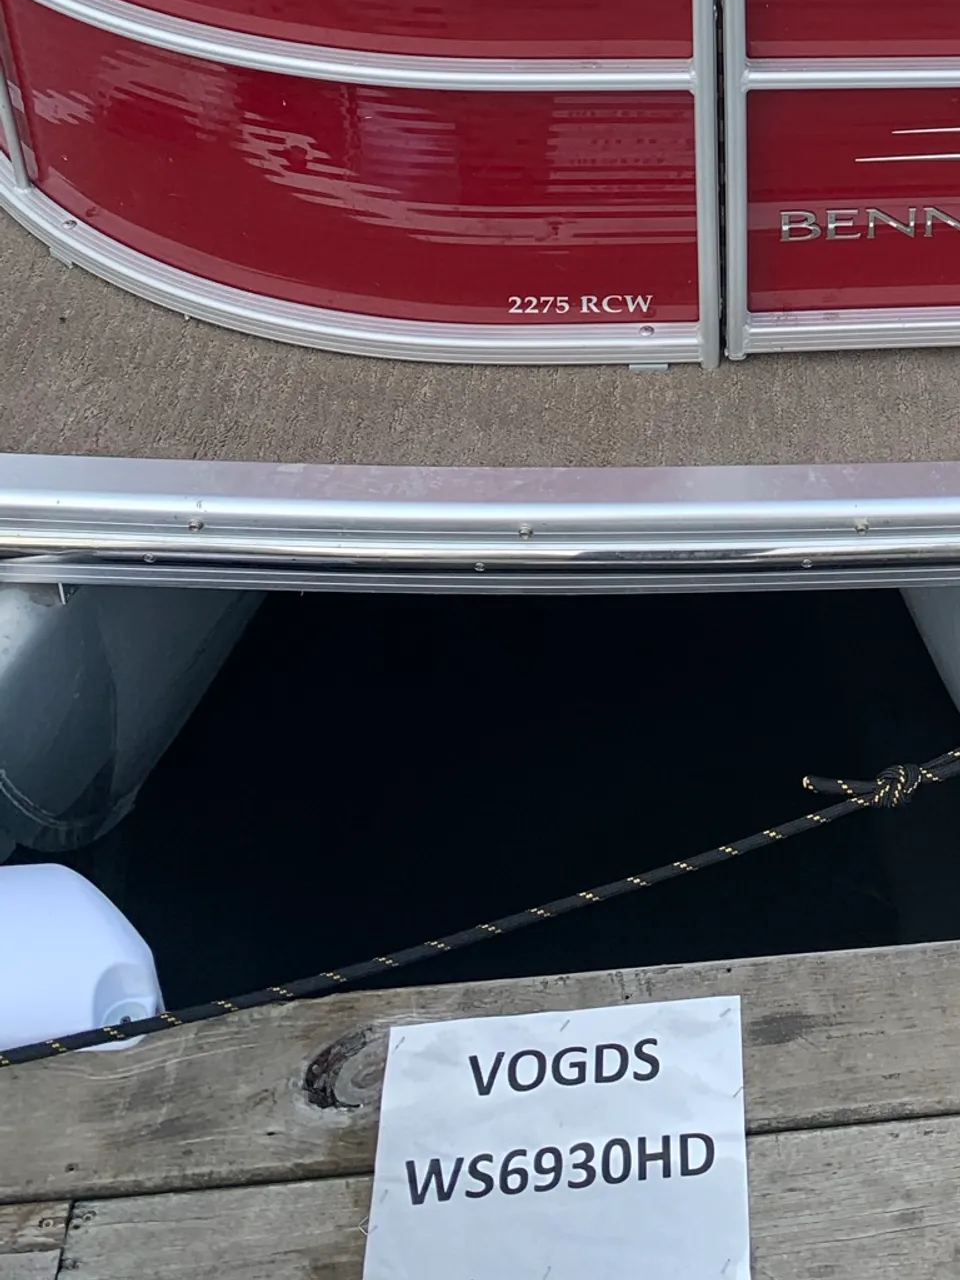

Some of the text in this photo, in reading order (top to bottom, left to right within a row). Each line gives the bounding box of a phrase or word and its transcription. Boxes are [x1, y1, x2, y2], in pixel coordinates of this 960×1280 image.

[508, 294, 653, 314] 2275 RCW
[468, 1038, 661, 1096] VOGDS
[405, 1132, 715, 1206] WS6930HD
